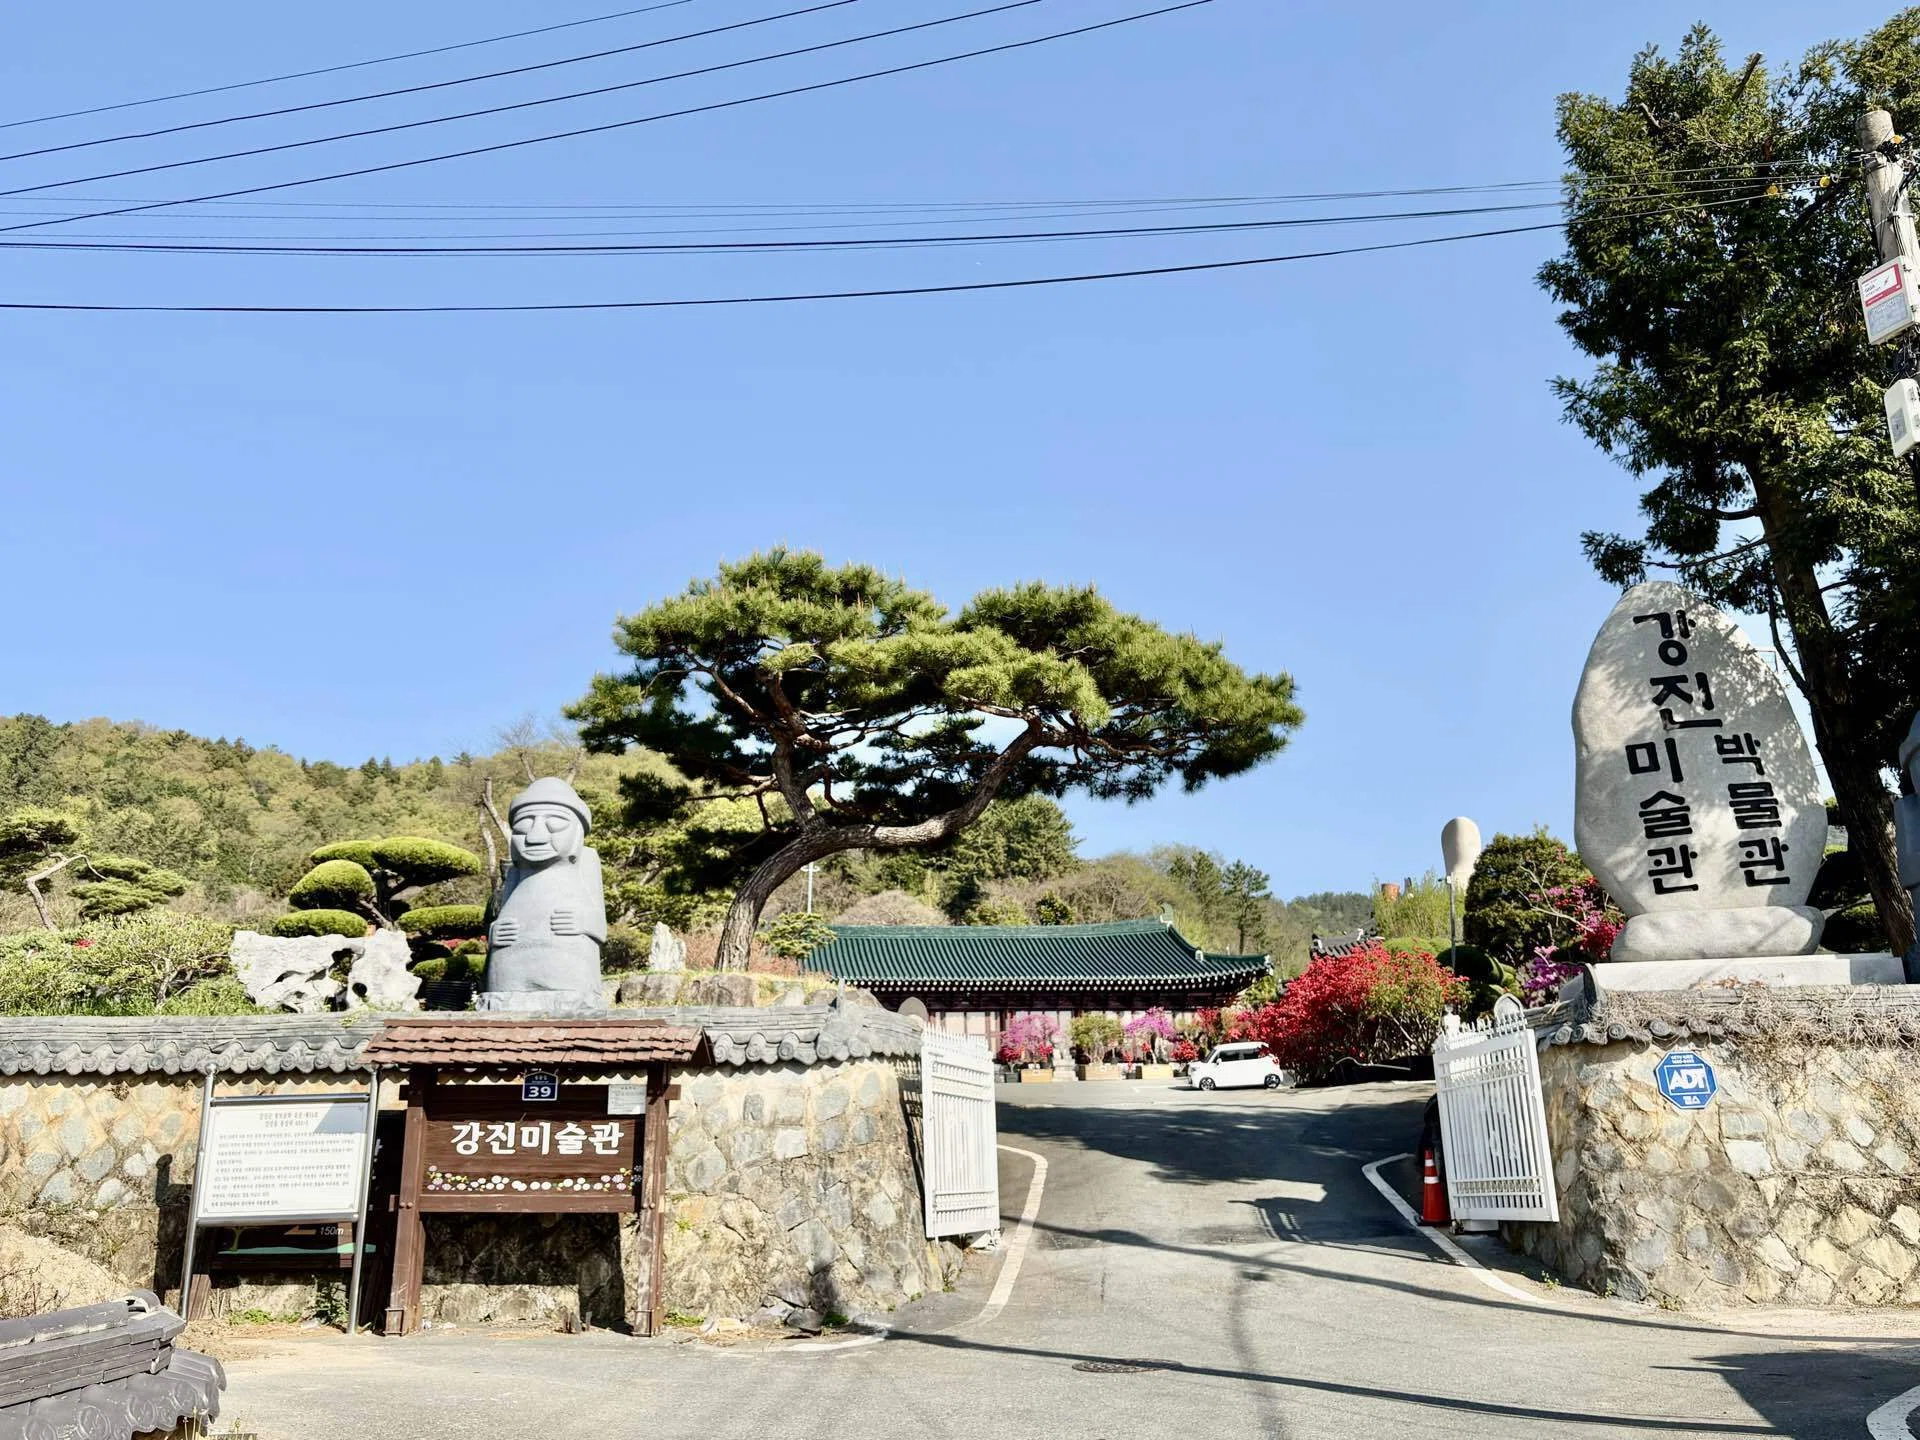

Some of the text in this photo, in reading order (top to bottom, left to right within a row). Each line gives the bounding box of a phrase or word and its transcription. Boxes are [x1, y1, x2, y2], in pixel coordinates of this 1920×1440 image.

[1713, 732, 1791, 888] 박물관
[1669, 1068, 1705, 1090] ADT
[528, 1086, 551, 1098] 39
[450, 1121, 625, 1156] 강진미술관
[319, 1226, 344, 1236] 150m
